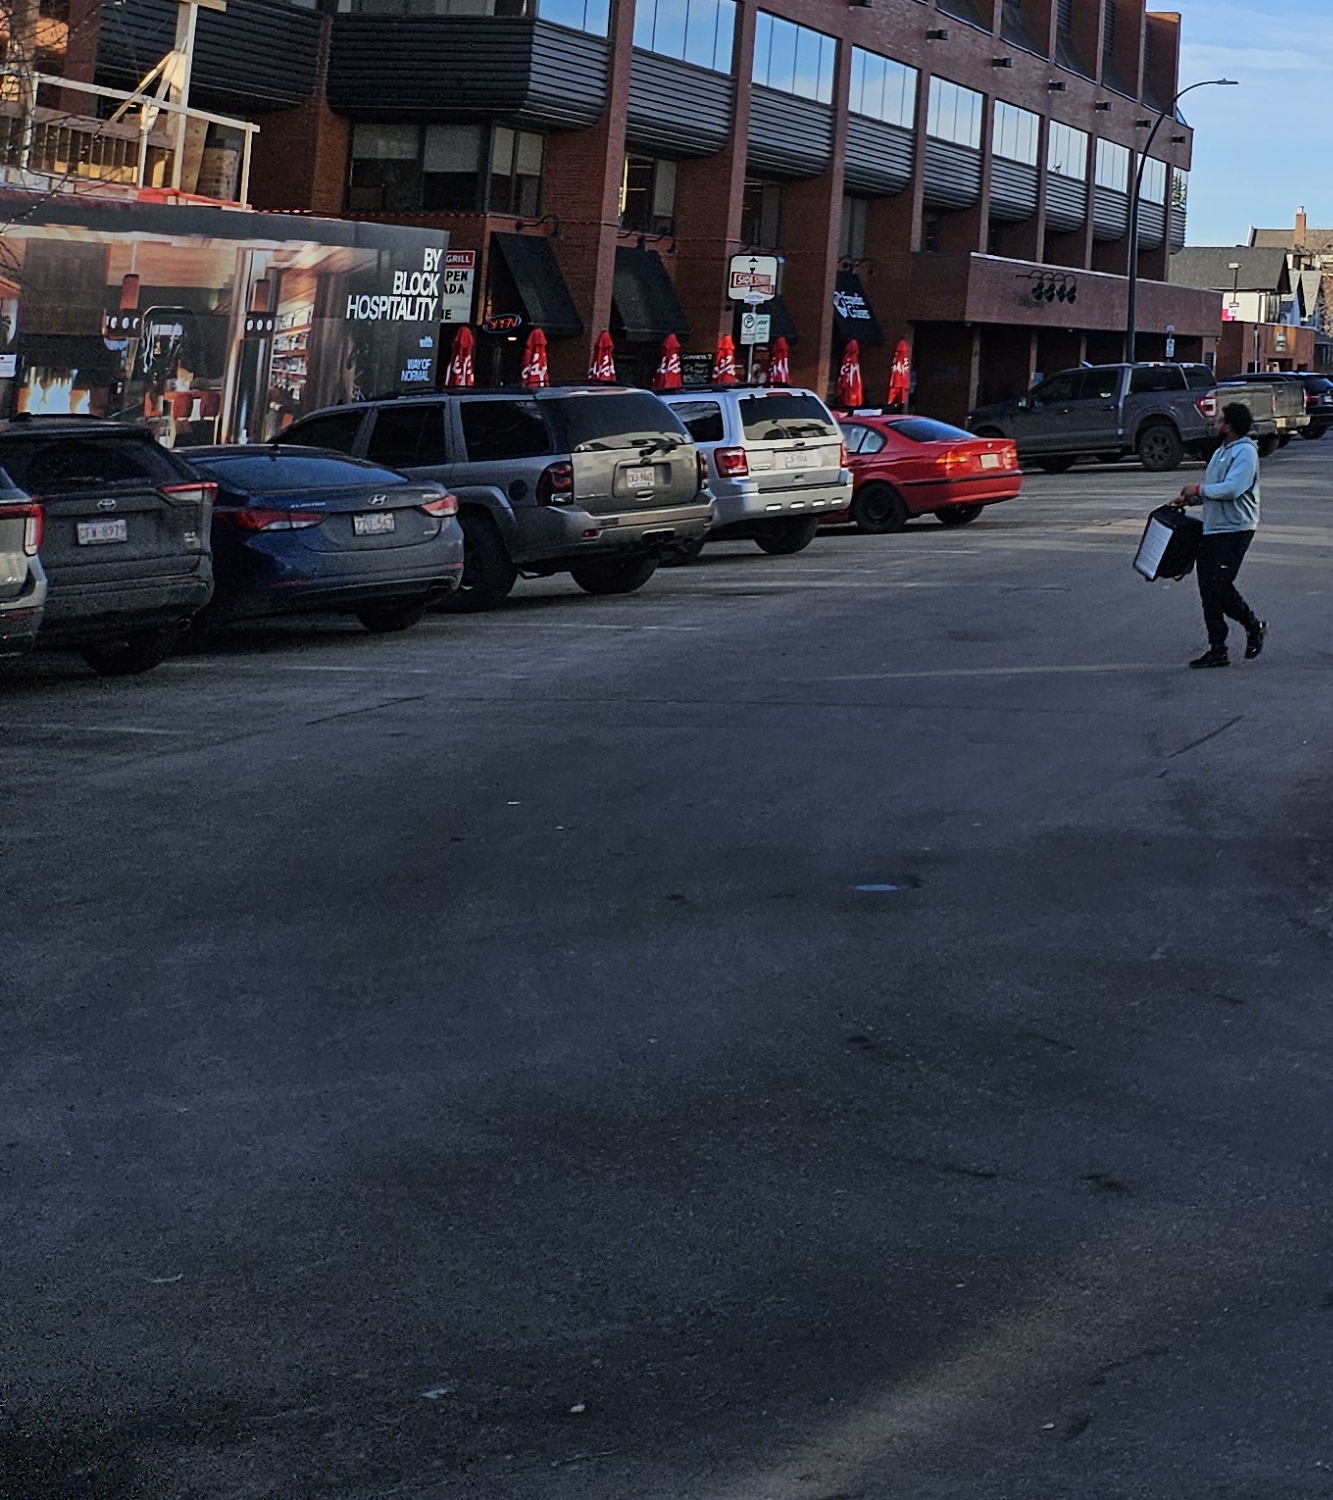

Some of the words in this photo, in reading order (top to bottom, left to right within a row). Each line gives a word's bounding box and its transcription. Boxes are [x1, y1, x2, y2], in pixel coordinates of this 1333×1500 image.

[423, 247, 443, 272] BY
[446, 255, 470, 263] GRILL
[392, 271, 440, 297] BLOCK
[445, 270, 468, 282] PEN
[346, 294, 439, 321] HOSPITALITY
[401, 369, 430, 381] NORMAL
